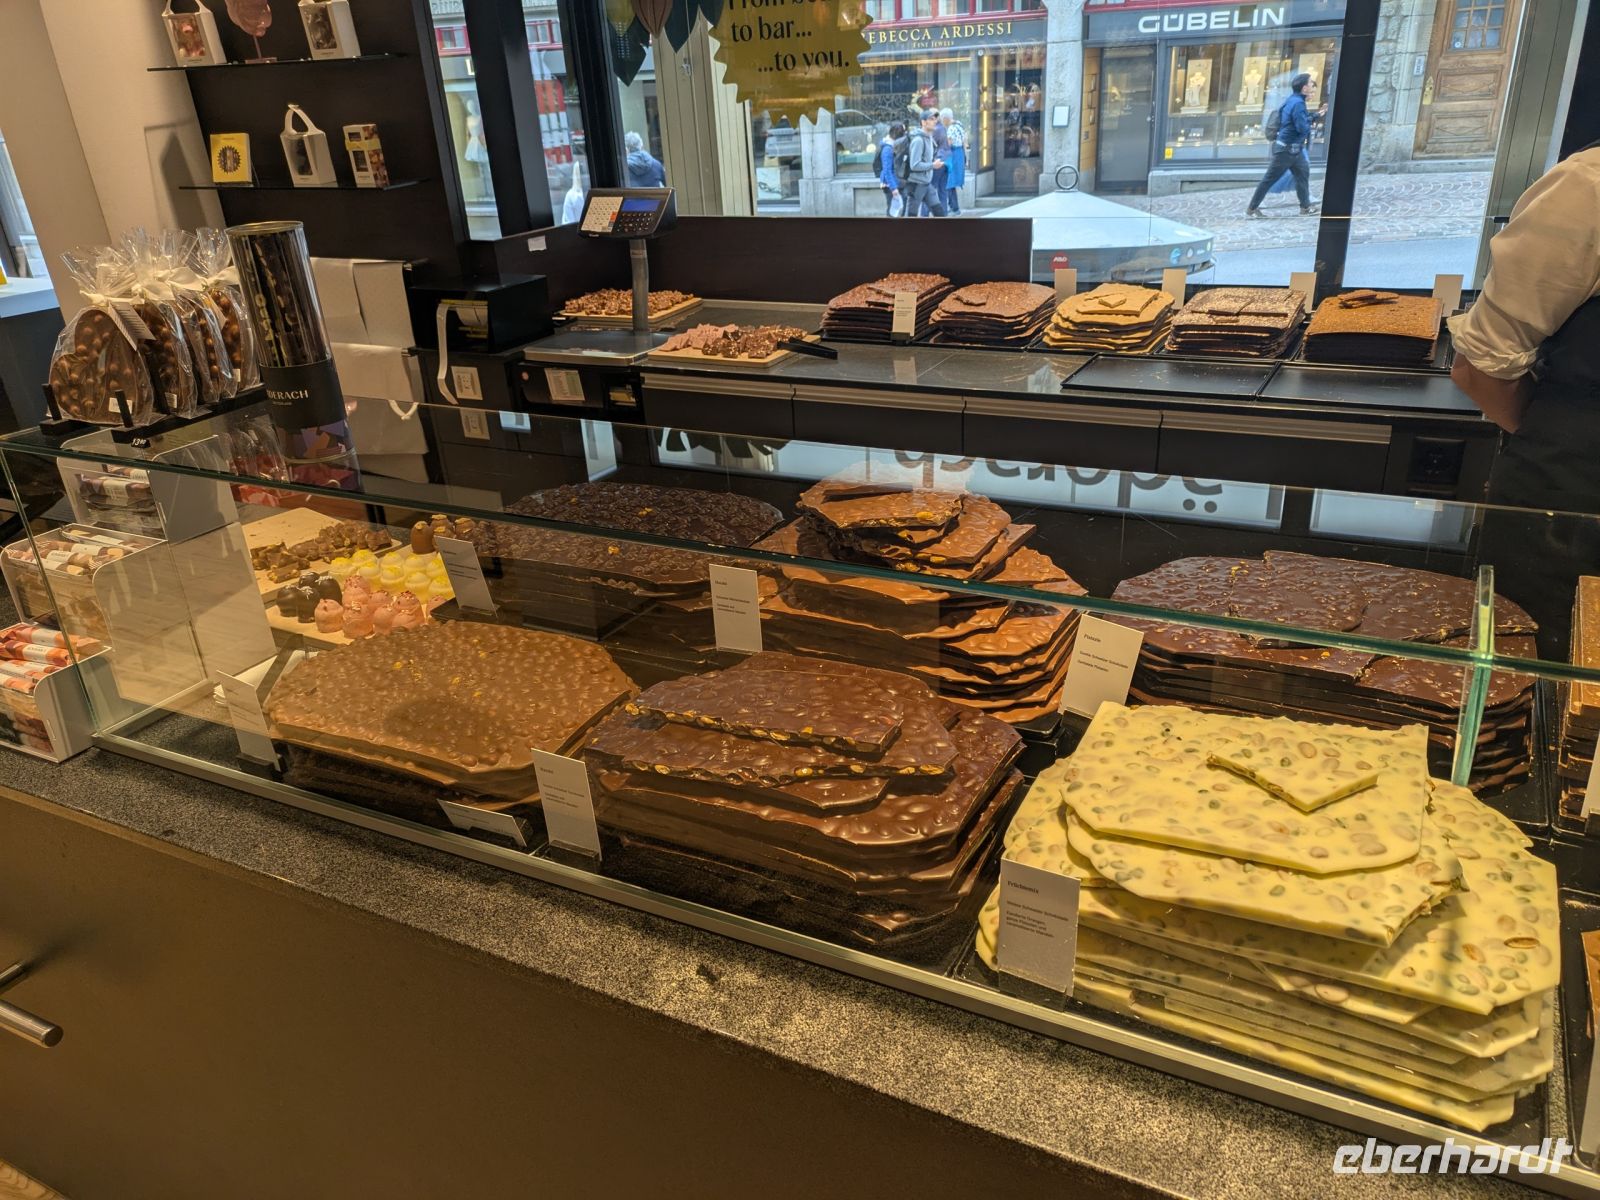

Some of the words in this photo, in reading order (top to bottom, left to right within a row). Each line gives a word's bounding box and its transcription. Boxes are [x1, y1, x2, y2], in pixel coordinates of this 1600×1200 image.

[732, 21, 753, 43] to
[758, 16, 812, 41] bar...
[940, 22, 1012, 39] ARDESSI
[1138, 7, 1285, 33] GÜBELIN
[758, 51, 796, 72] ...to
[802, 50, 850, 75] you.
